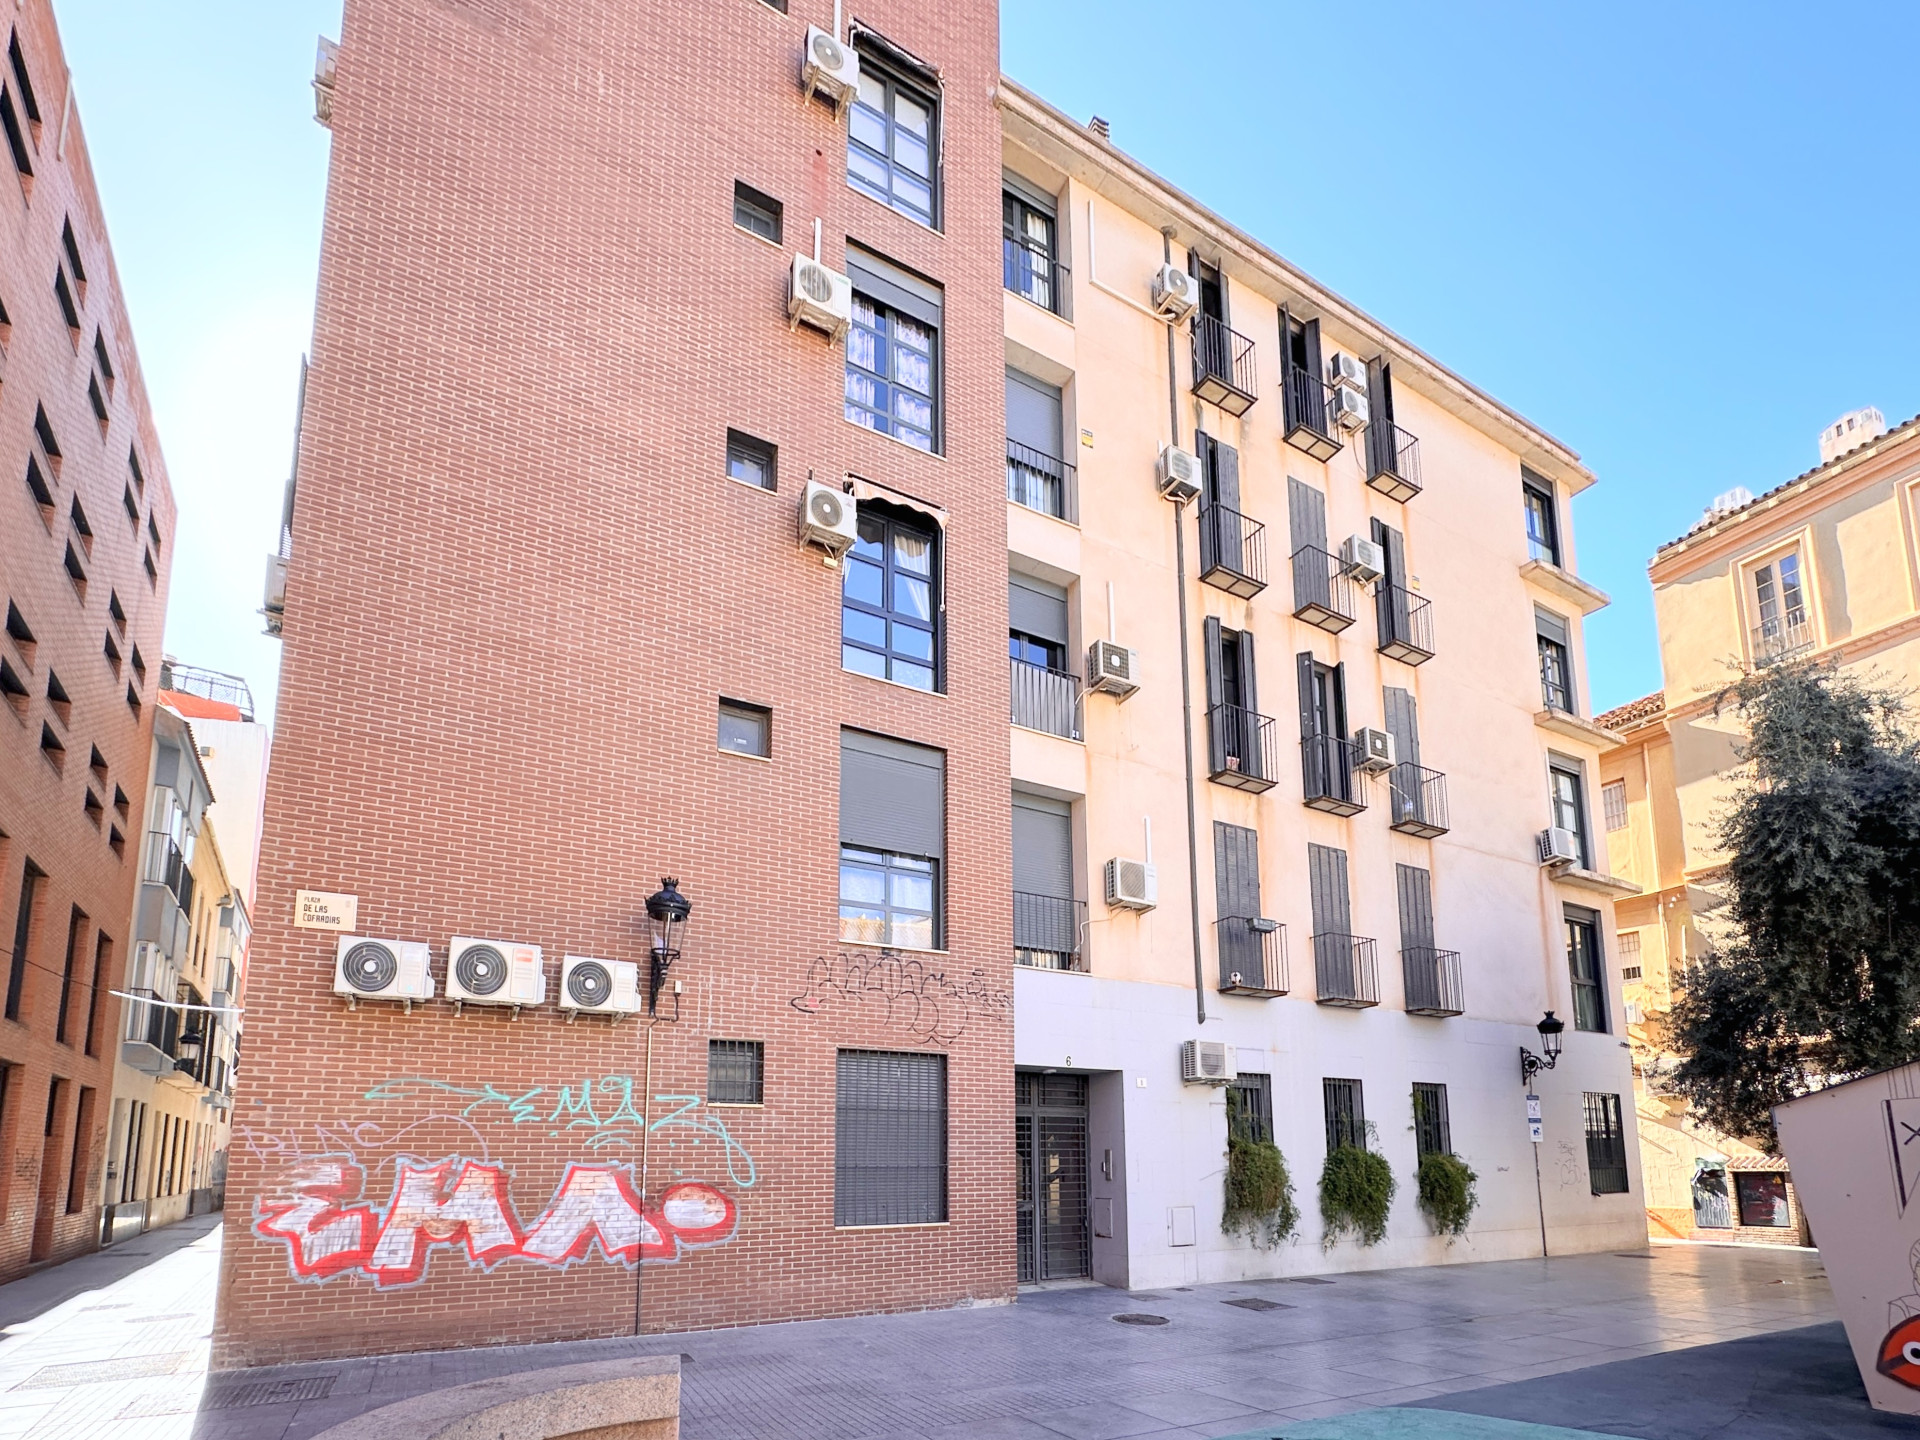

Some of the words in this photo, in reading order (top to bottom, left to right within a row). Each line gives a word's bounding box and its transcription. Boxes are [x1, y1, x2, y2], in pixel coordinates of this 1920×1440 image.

[303, 903, 313, 912] DE
[314, 905, 328, 913] LAS
[1065, 1055, 1072, 1067] 6
